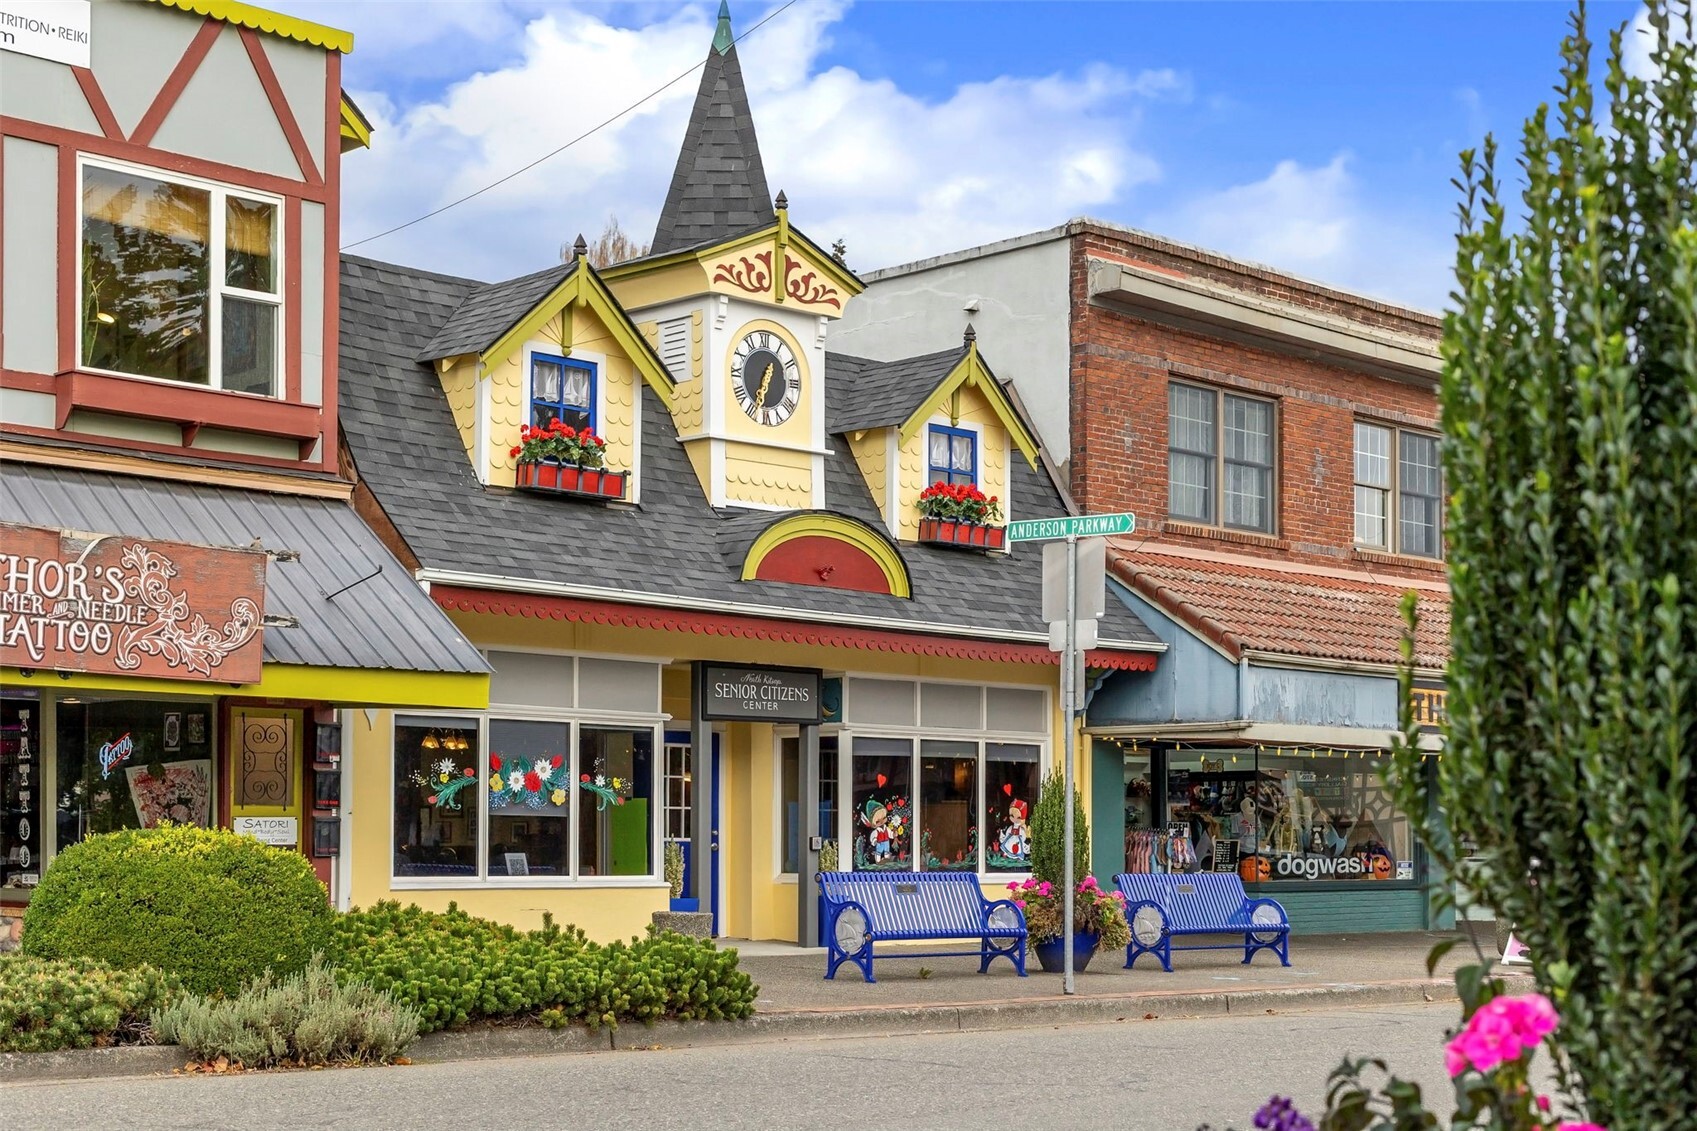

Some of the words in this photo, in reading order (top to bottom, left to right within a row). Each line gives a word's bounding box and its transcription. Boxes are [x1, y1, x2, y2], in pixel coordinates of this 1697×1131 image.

[58, 26, 88, 44] REIKI
[1010, 521, 1067, 539] ANDERSON
[1071, 516, 1123, 535] PARKWAY
[0, 591, 46, 615] MER
[50, 601, 71, 617] AND
[77, 600, 149, 625] NEEDLE
[715, 682, 758, 700] SENIOR
[760, 685, 809, 702] CITIZENS
[742, 701, 779, 711] CENTER
[17, 709, 32, 868] TATTOO
[242, 818, 289, 829] SATORI
[1277, 853, 1374, 880] dogwash
